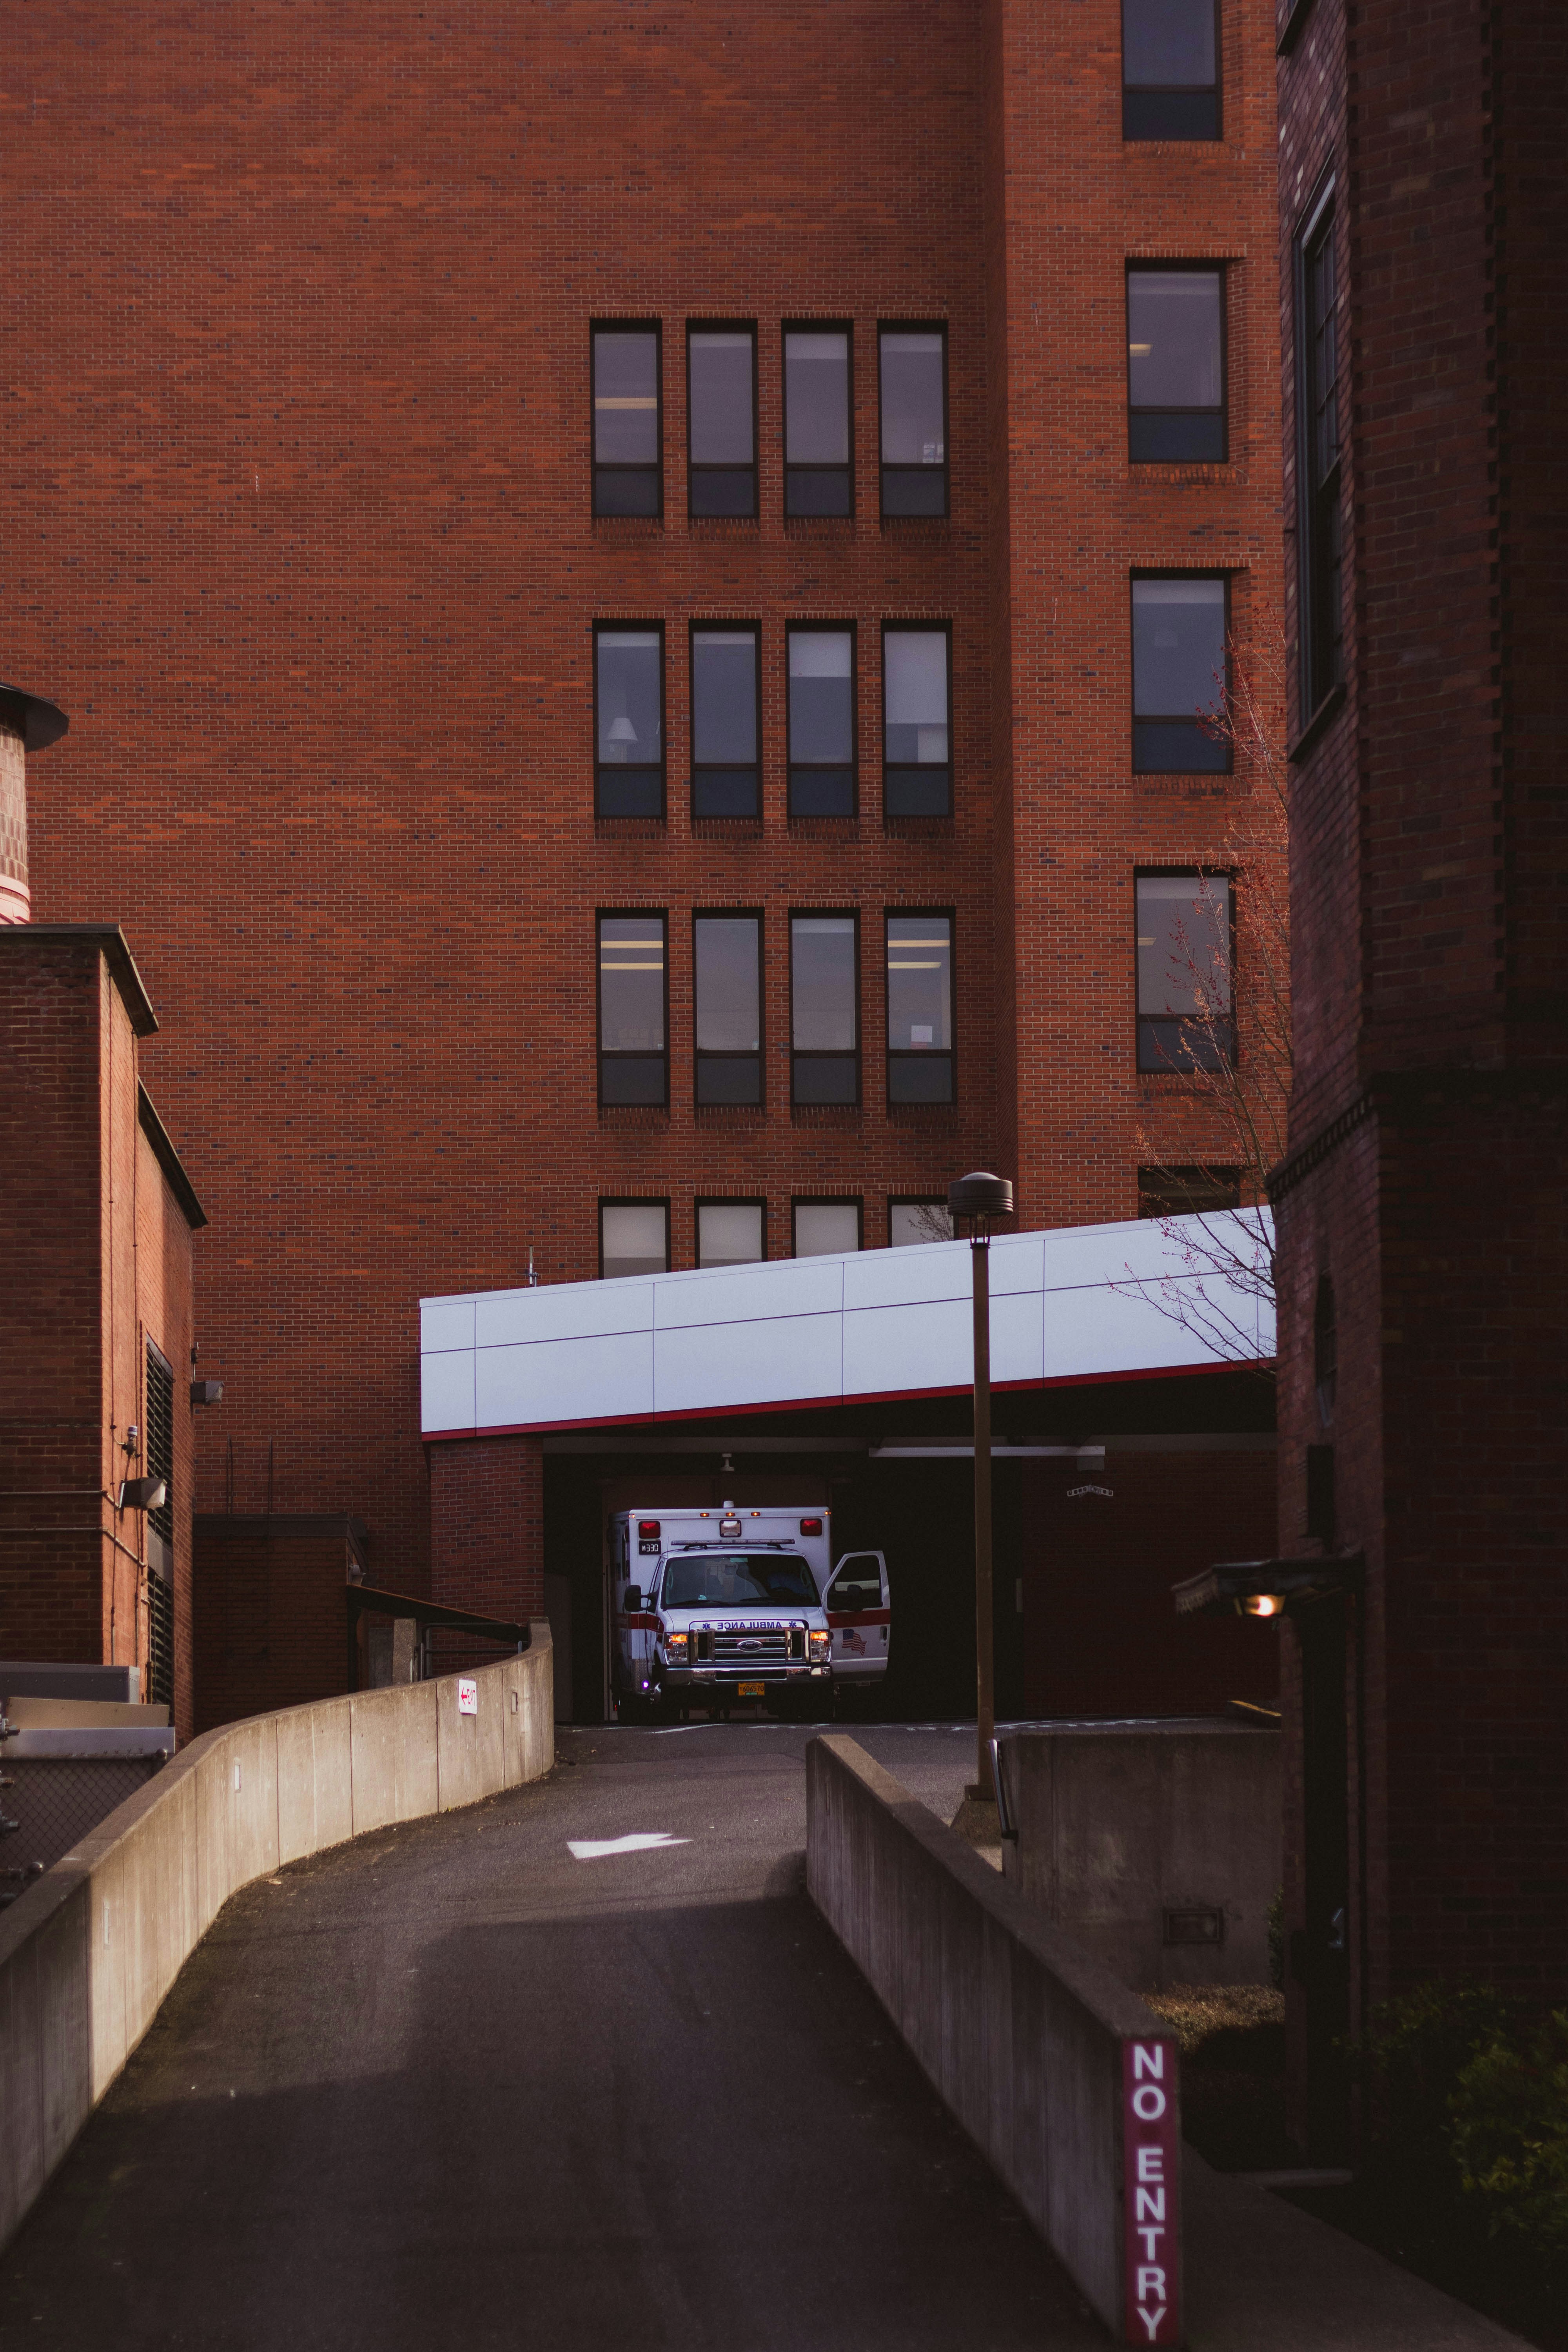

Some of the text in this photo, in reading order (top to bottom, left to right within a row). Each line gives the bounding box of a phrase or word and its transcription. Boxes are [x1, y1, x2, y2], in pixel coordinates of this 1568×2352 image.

[642, 1544, 659, 1552] M330
[1133, 2045, 1167, 2341] NO ENTRY
